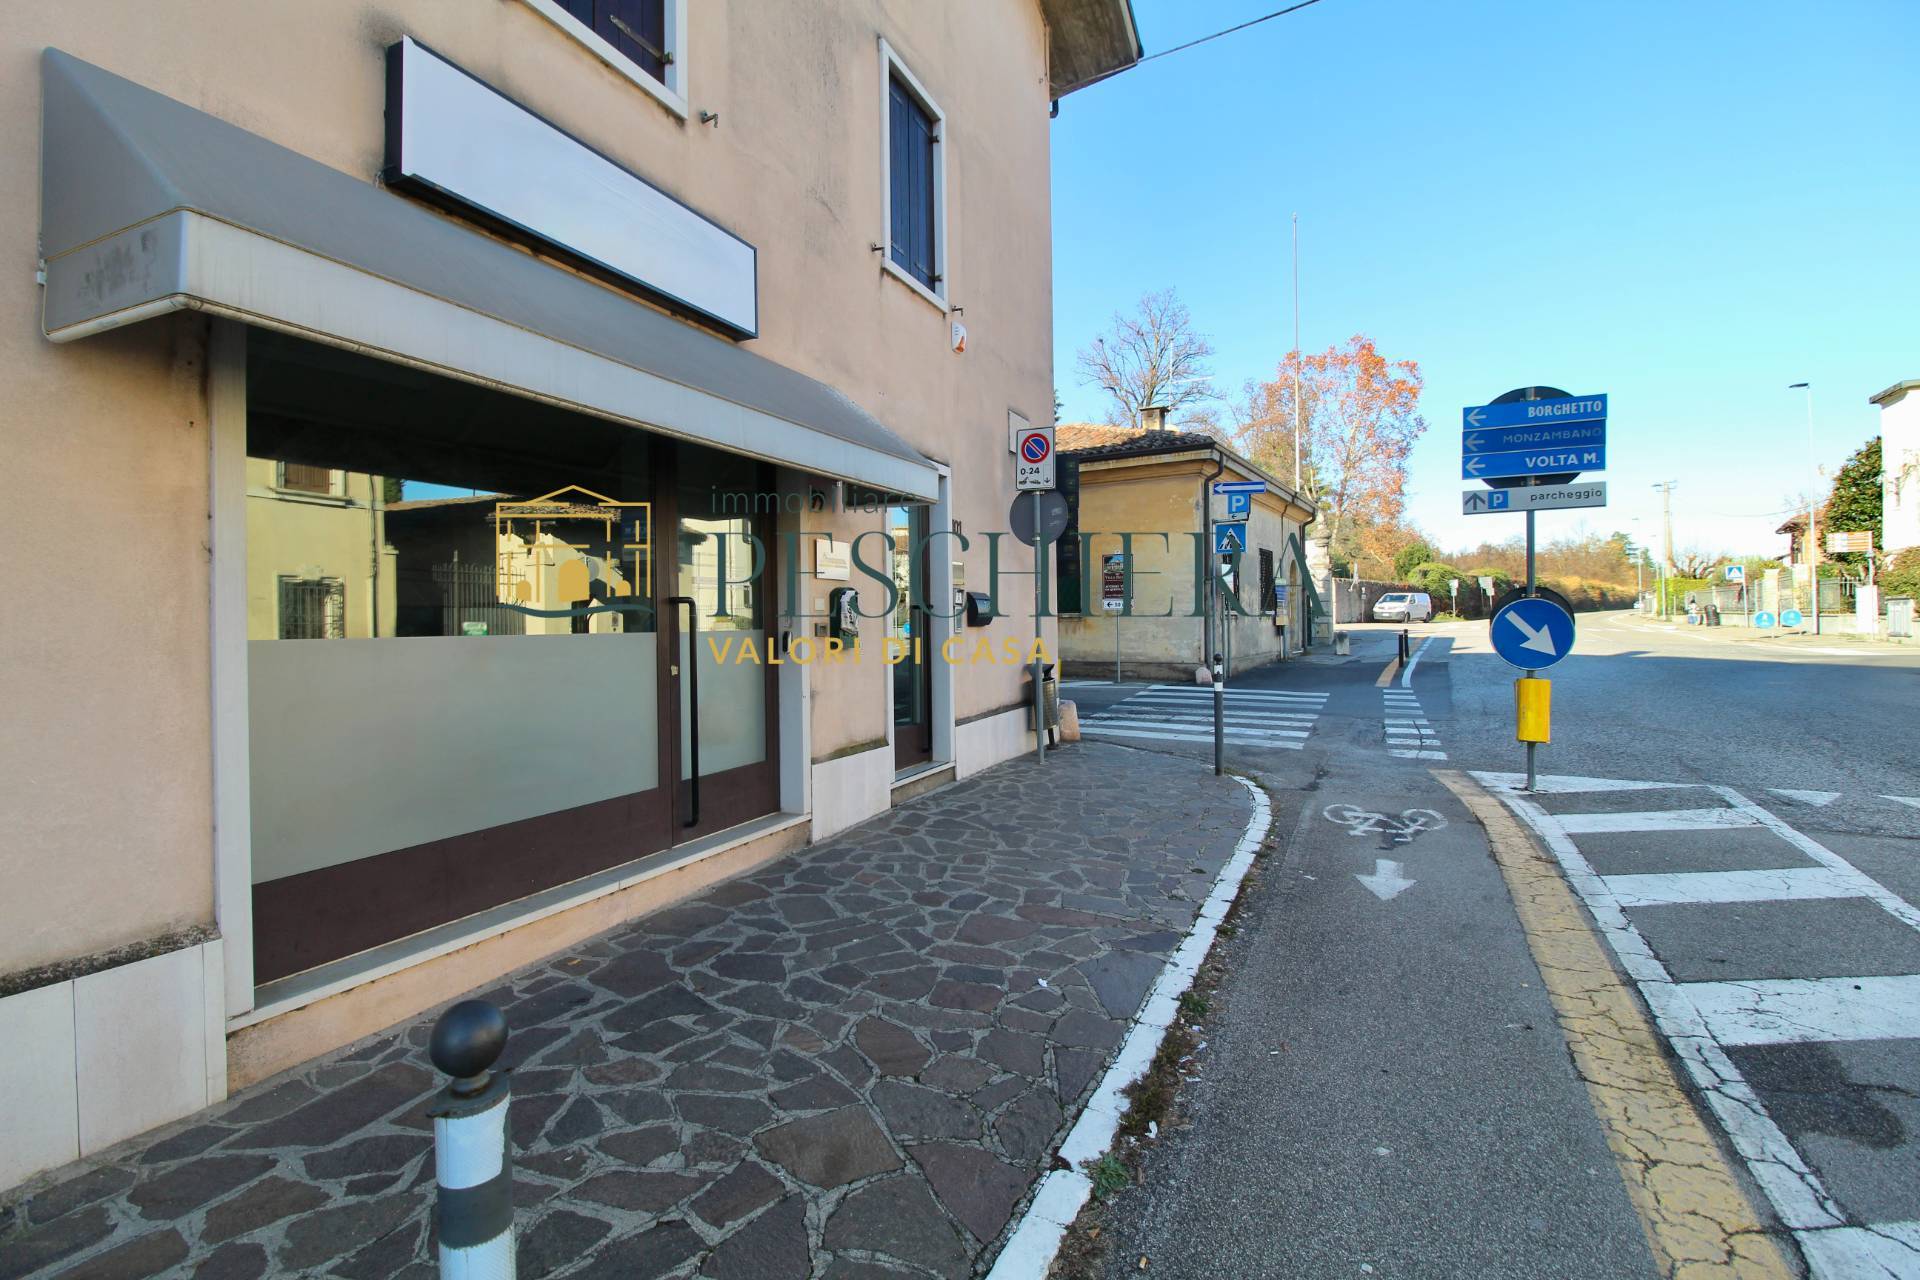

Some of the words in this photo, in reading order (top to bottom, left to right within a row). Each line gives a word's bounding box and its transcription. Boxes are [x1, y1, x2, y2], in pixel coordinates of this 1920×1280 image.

[1528, 400, 1602, 418] BORGHETTO
[1503, 427, 1602, 444] MONZAMBANO
[1525, 454, 1578, 468] VOLTA
[1583, 452, 1601, 464] M.
[1020, 467, 1040, 475] 0-24
[1231, 495, 1245, 512] P
[1493, 493, 1504, 506] P
[1530, 487, 1602, 503] parcheggio
